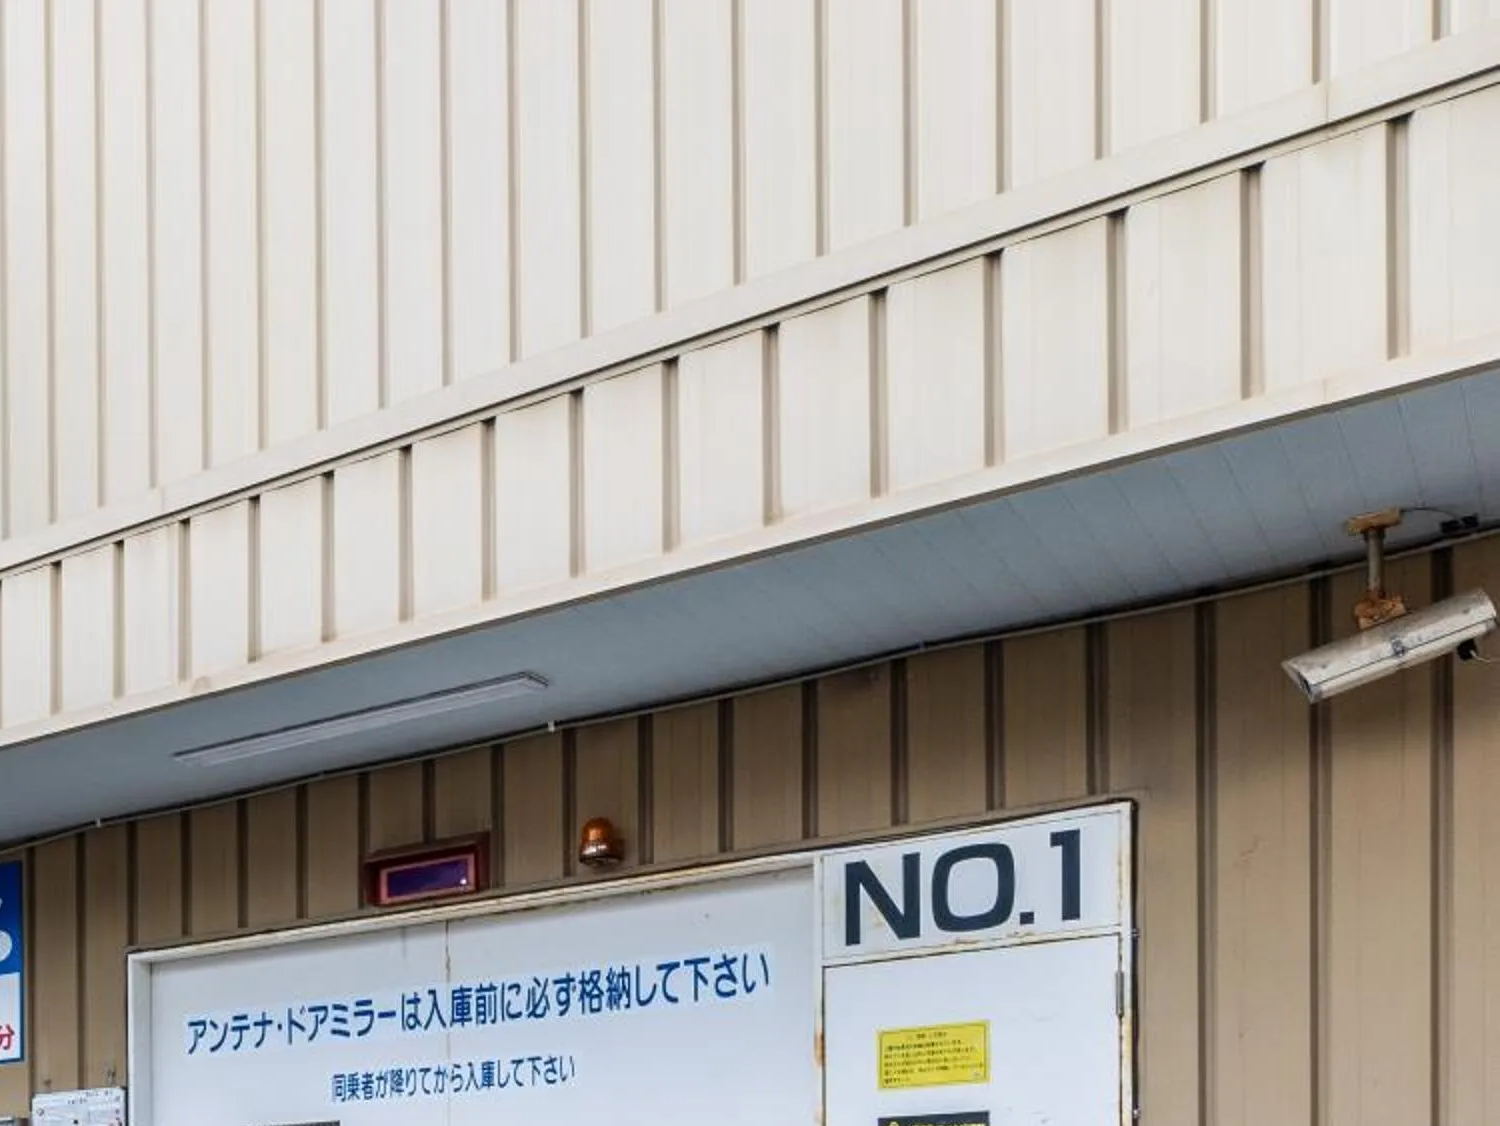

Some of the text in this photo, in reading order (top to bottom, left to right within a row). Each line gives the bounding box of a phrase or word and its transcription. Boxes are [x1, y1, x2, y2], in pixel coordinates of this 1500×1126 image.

[843, 828, 1081, 946] NO.1
[332, 1054, 576, 1103] 同乗者が降りてから入庫して下さい
